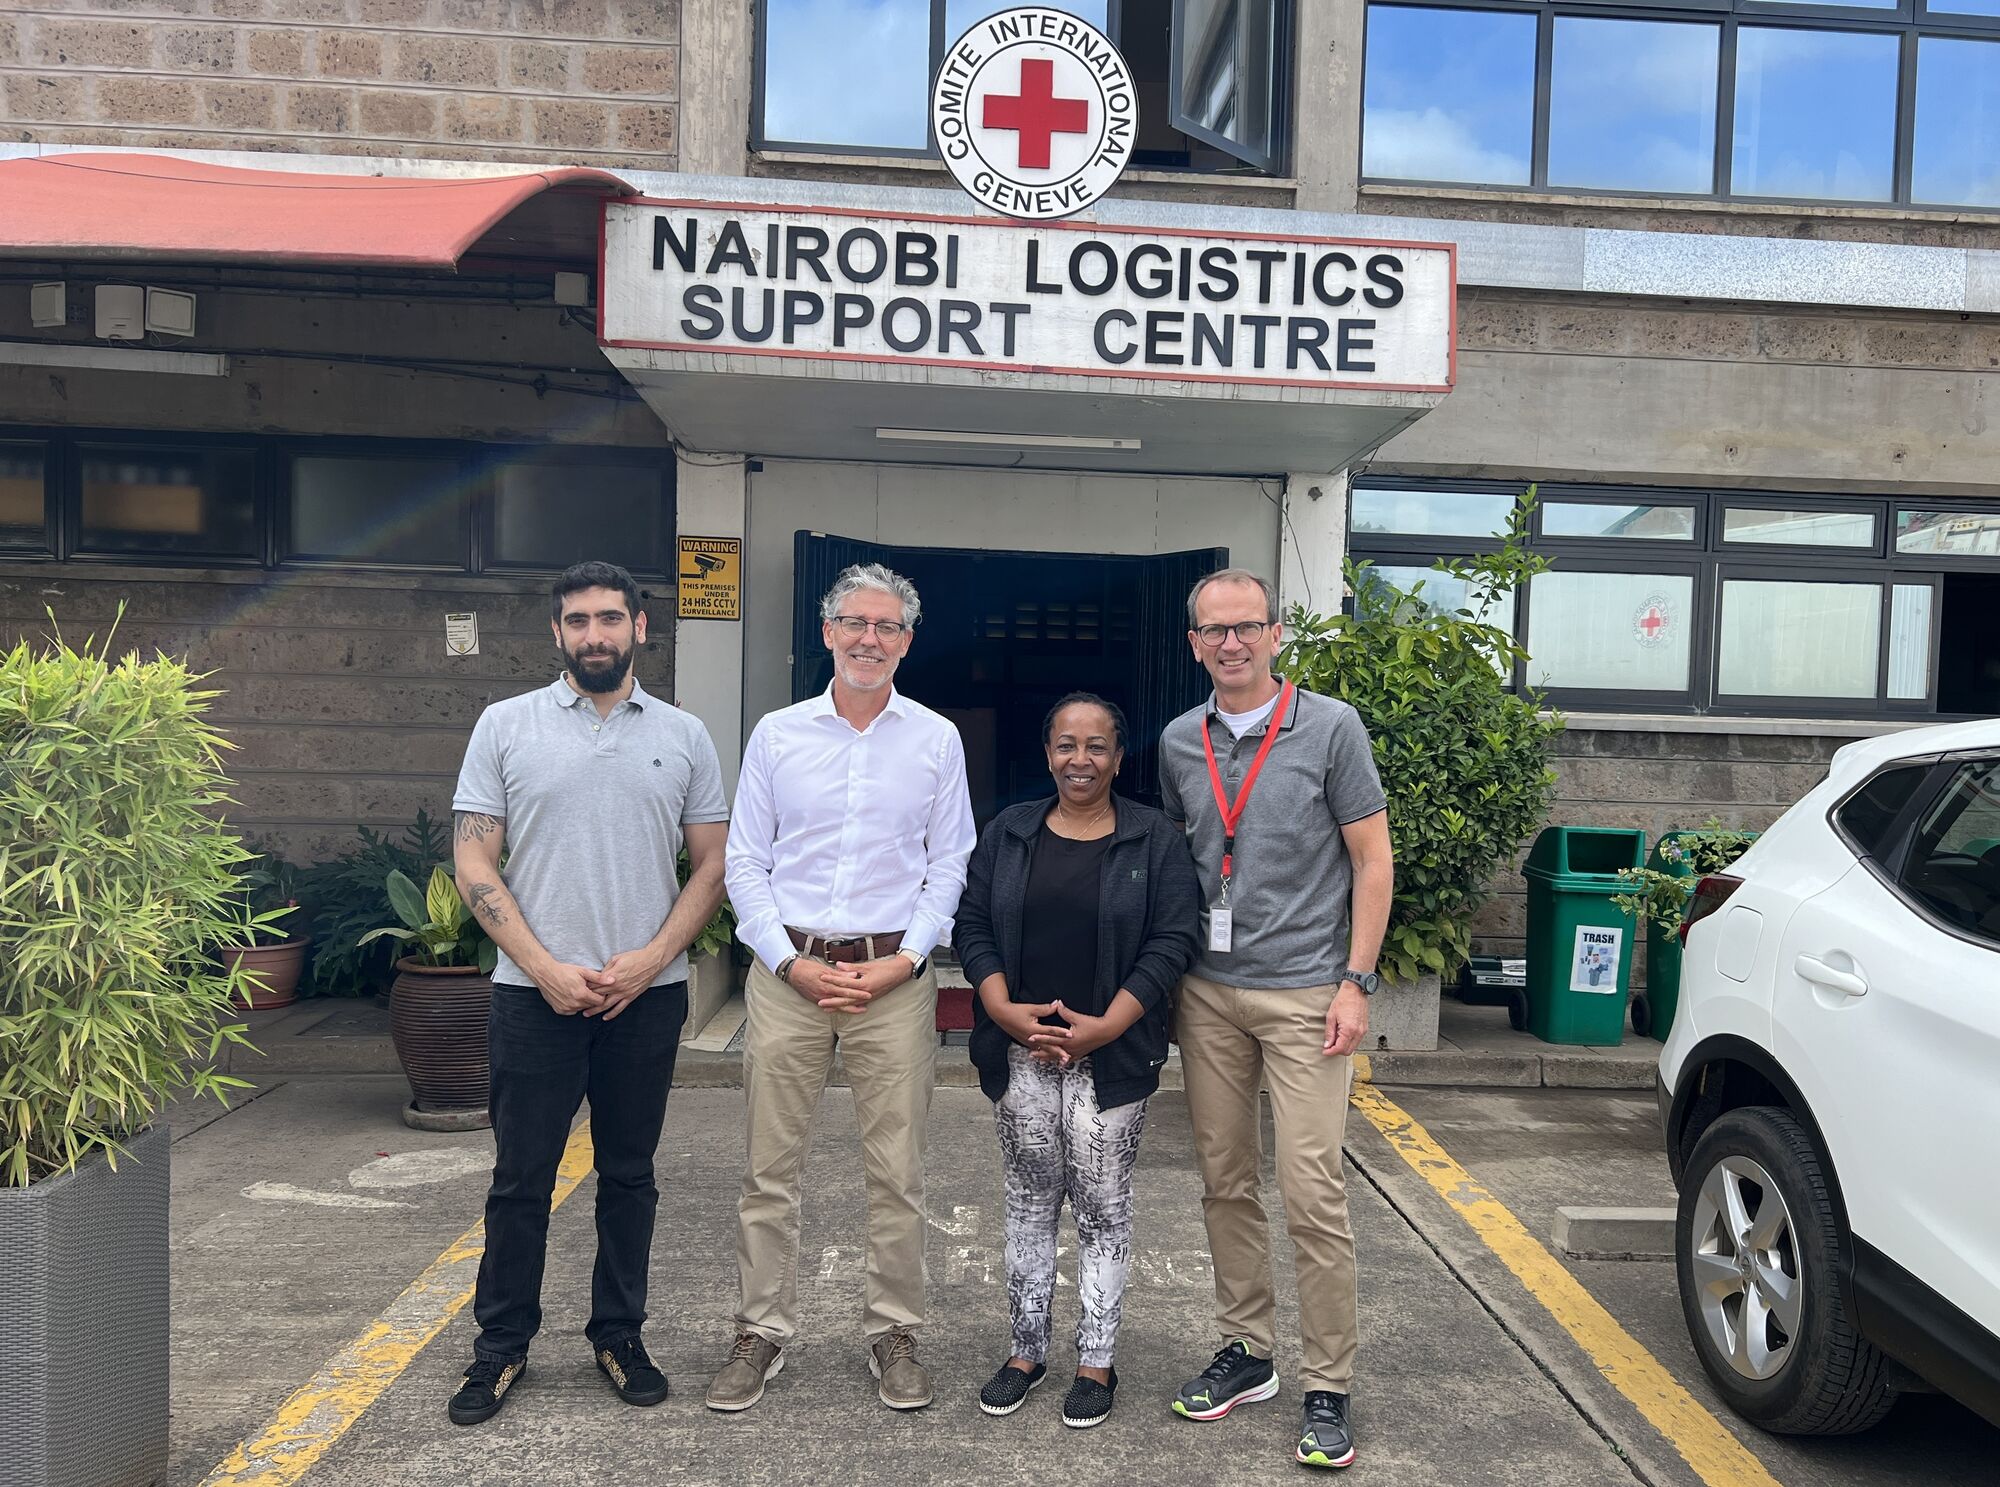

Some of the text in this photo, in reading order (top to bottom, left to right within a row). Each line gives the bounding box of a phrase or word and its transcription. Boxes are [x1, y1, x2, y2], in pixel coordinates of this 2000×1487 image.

[939, 14, 1131, 169] COMITE INTERNATIONAL
[973, 171, 1093, 213] GENEVE
[653, 216, 1404, 308] NAIROBI LOGISTICS
[681, 284, 1376, 371] SUPPORT CENTRE
[682, 541, 737, 553] WARNING
[700, 584, 736, 592] PREMISES
[682, 598, 736, 608] 24 HRS CCTV
[682, 608, 736, 616] SURVEILLANCE
[1583, 933, 1615, 944] TRASH
[1083, 1116, 1107, 1188] beautiful
